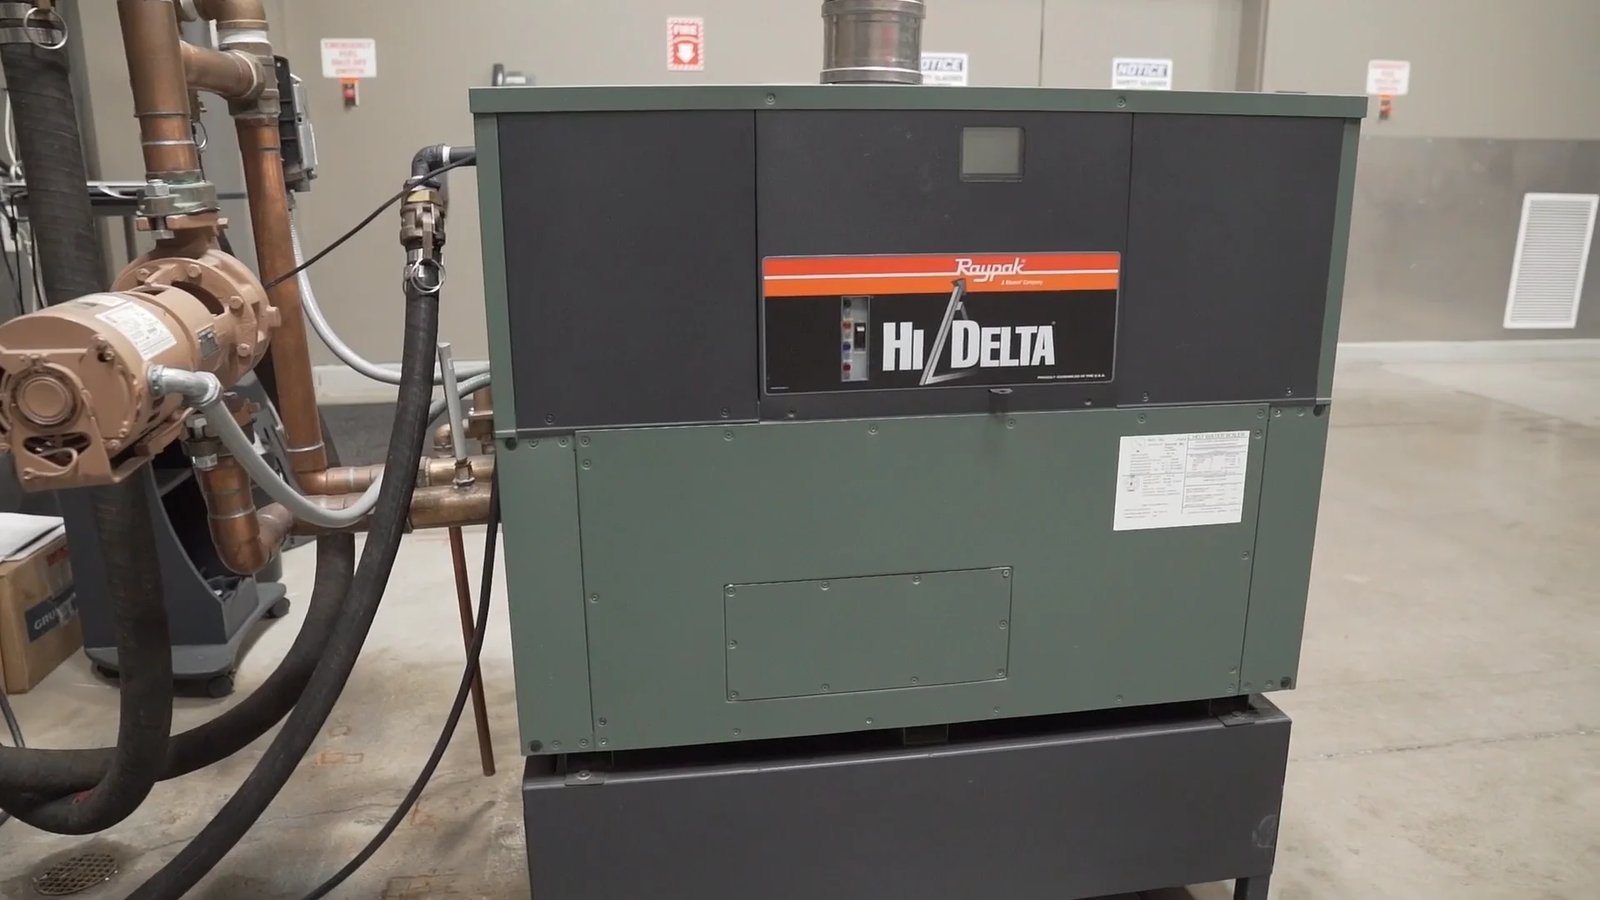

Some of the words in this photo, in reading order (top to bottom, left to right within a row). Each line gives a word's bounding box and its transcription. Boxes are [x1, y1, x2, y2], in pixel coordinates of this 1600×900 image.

[673, 24, 698, 35] FIRE
[921, 58, 962, 71] OTICE
[1117, 63, 1166, 77] NOTICE
[950, 319, 1055, 369] DELTA
